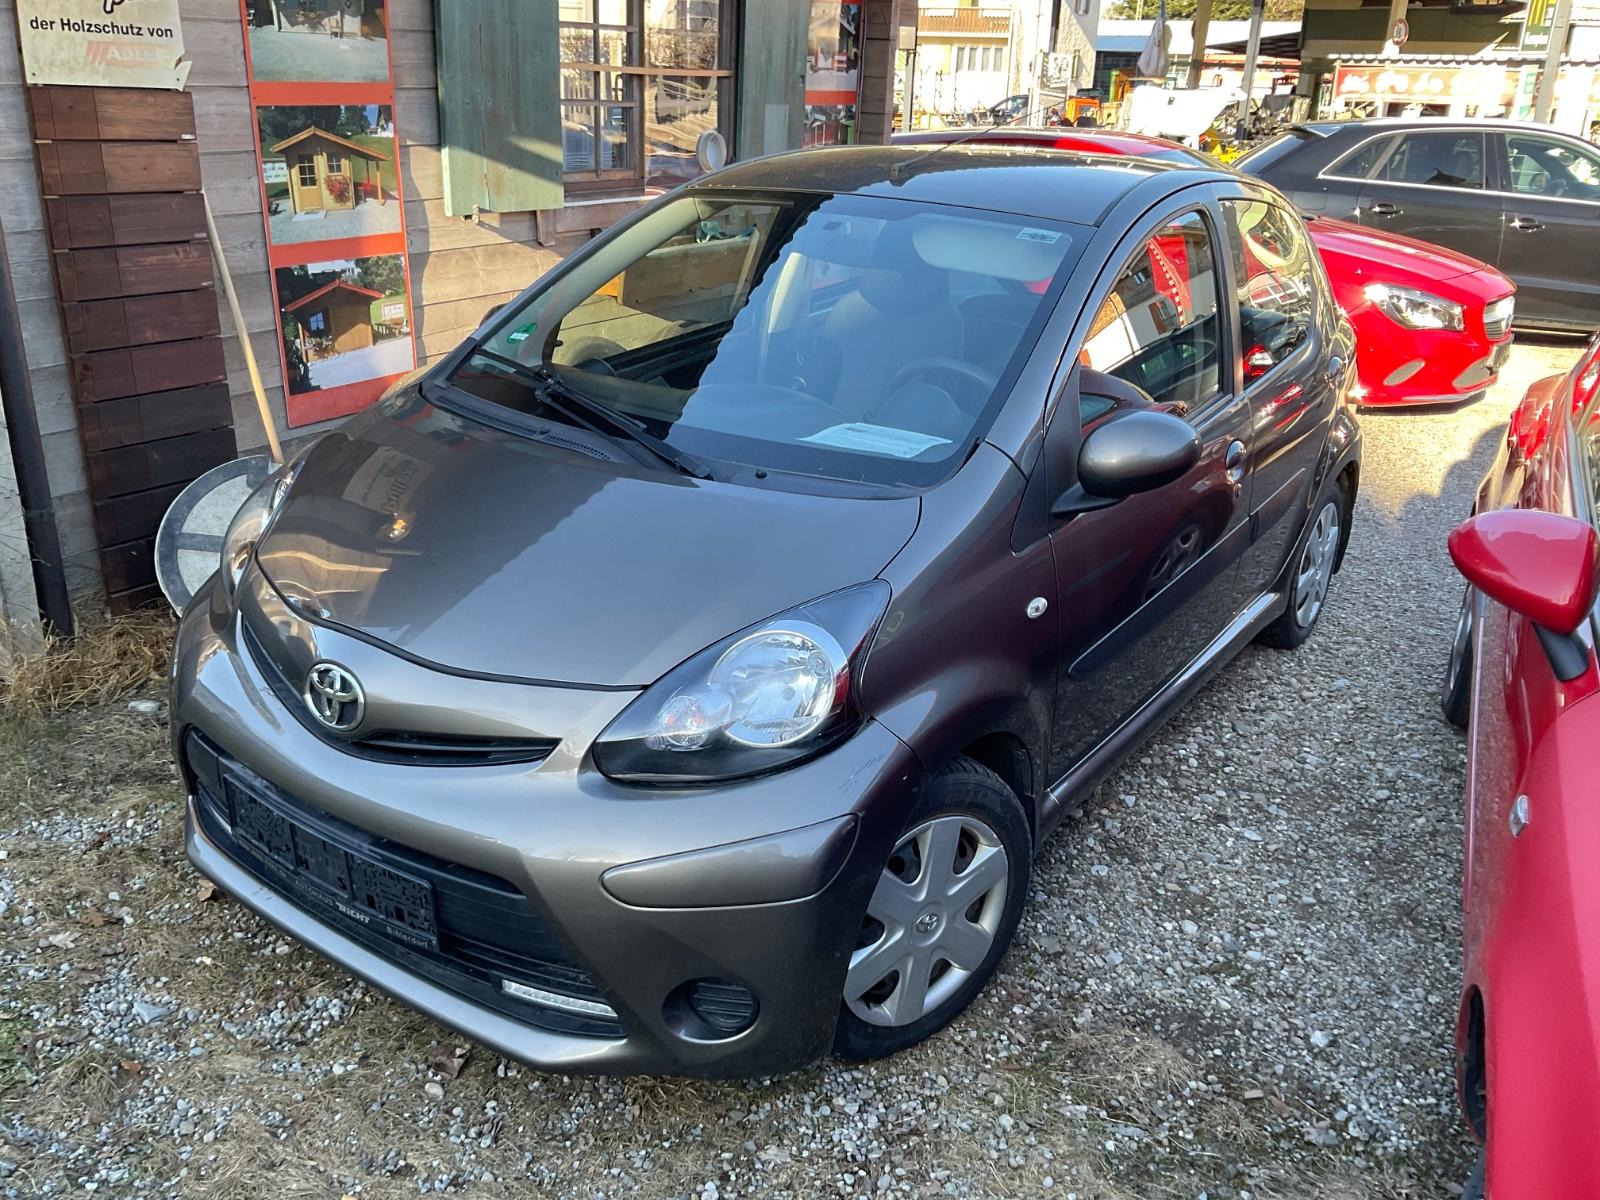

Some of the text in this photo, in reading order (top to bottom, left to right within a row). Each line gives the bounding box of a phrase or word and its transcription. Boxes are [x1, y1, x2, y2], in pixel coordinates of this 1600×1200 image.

[30, 16, 173, 38] der Holzschutz von
